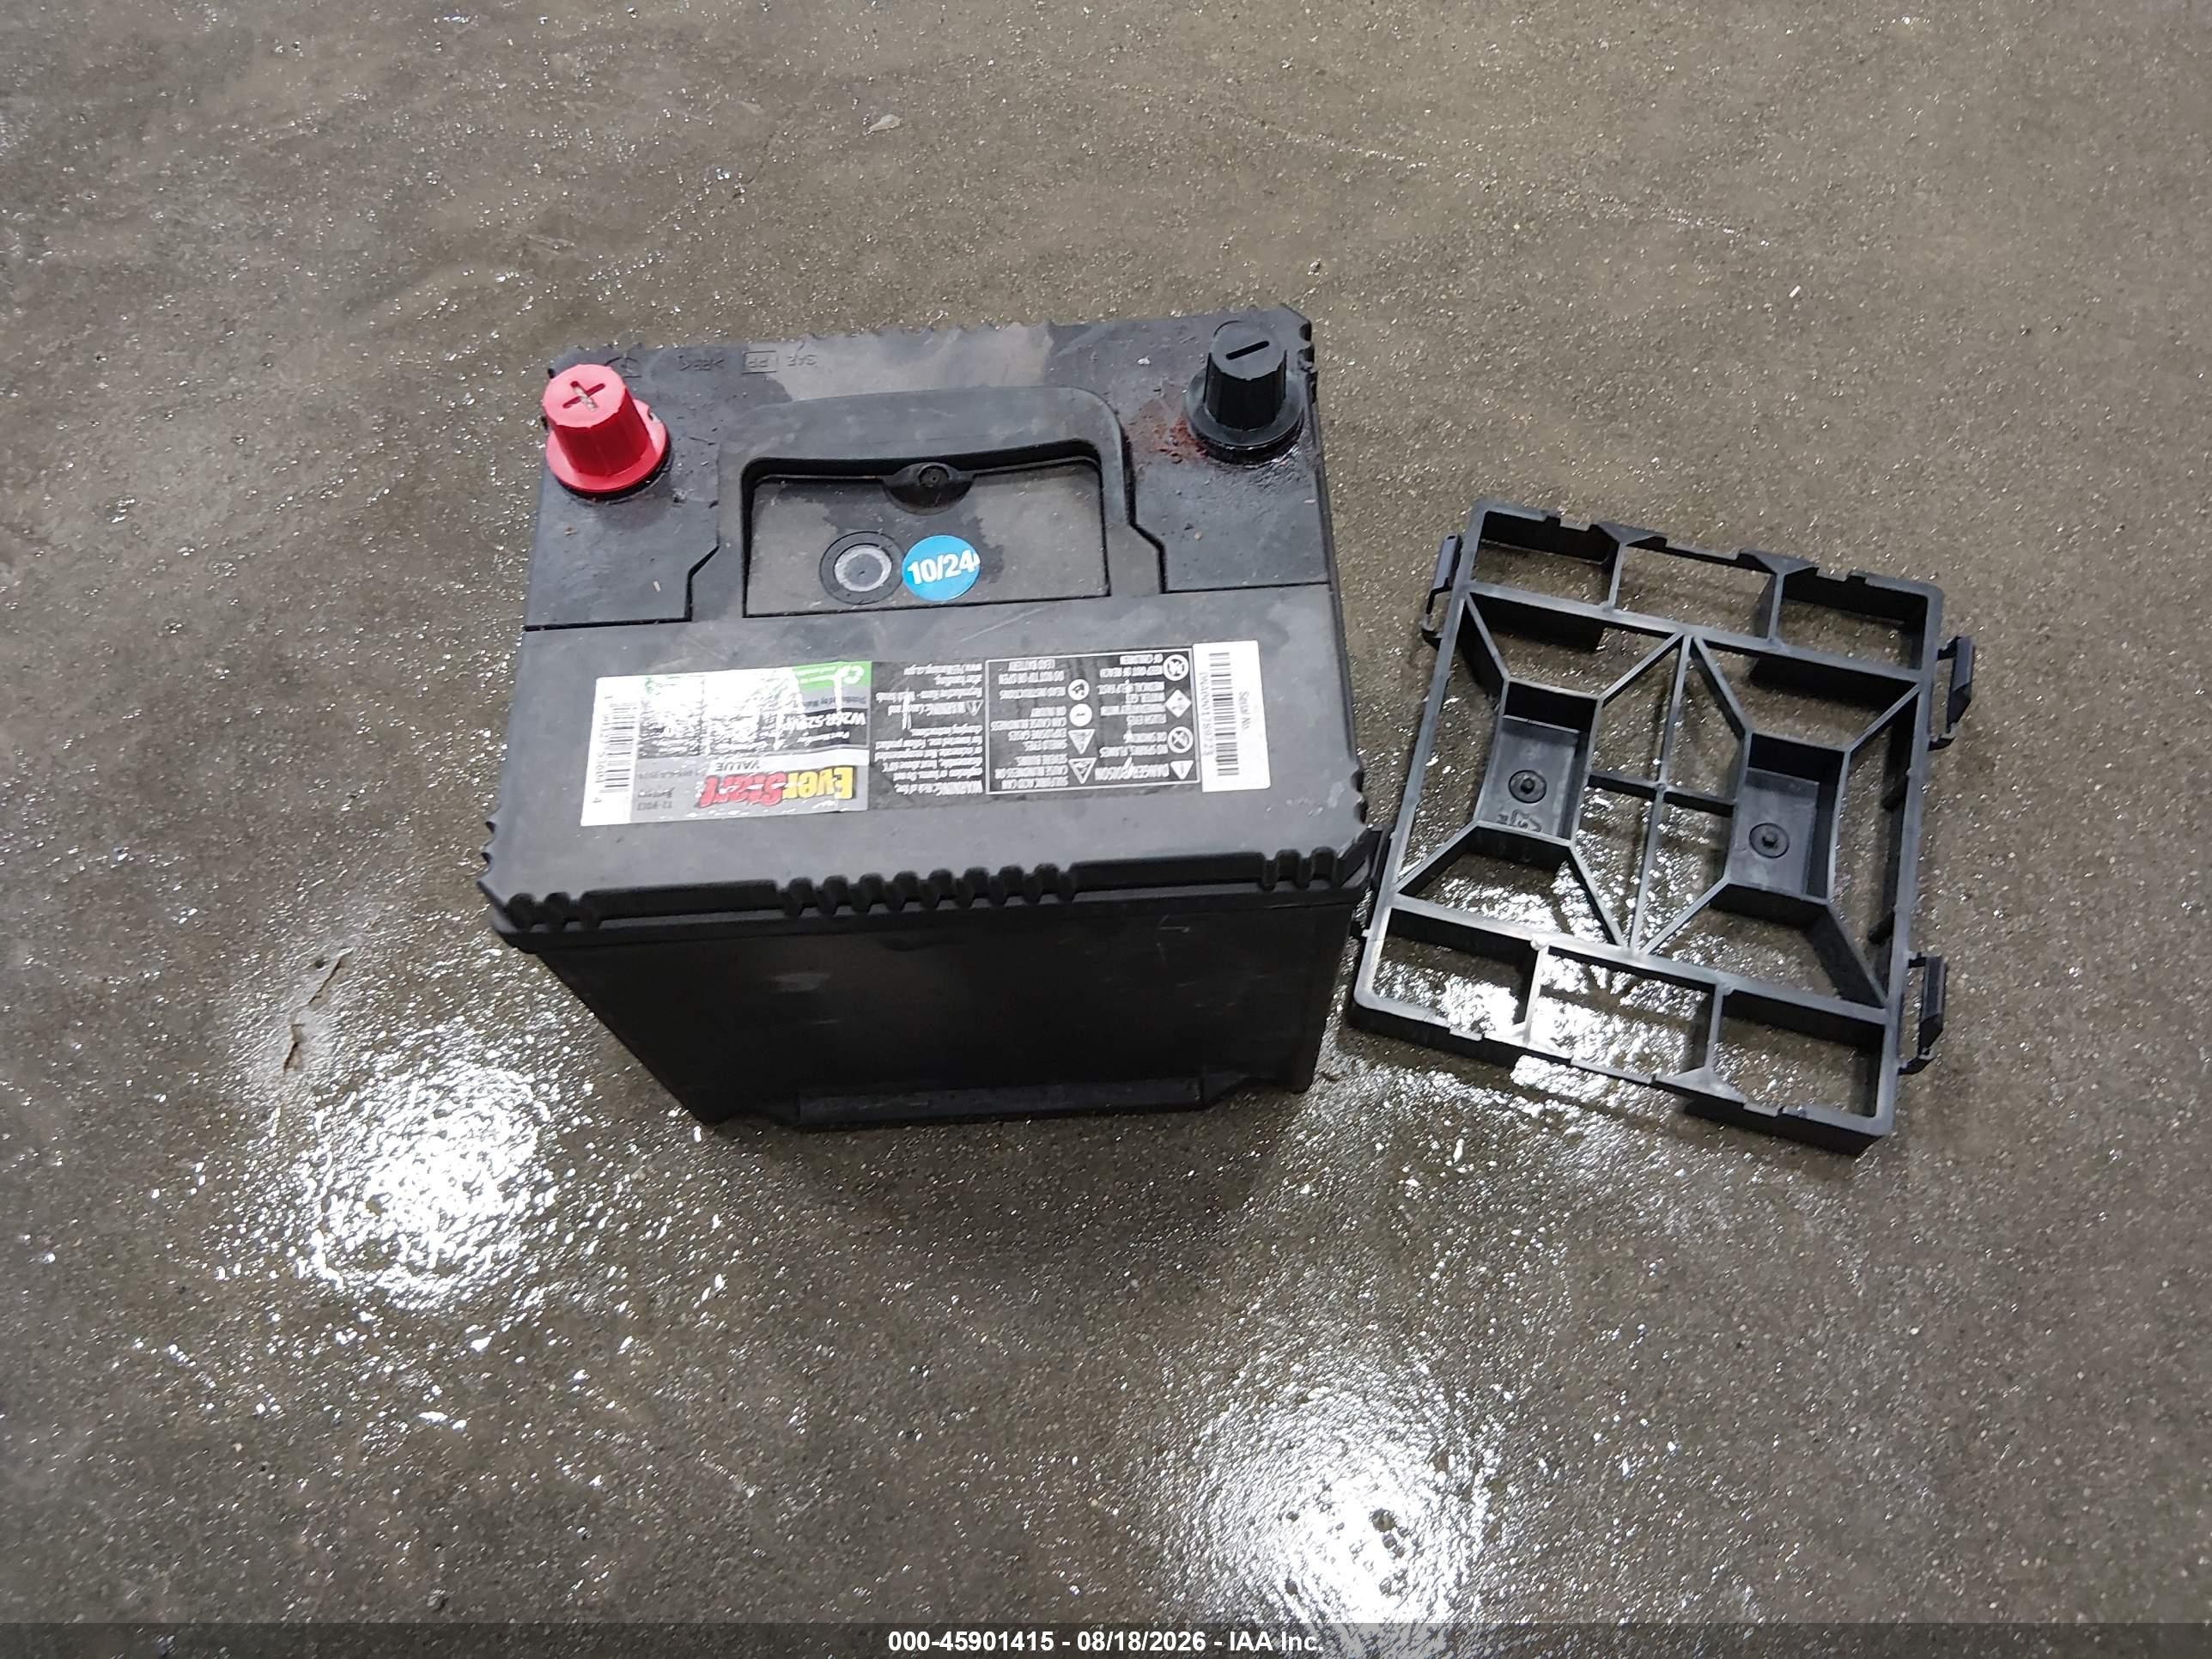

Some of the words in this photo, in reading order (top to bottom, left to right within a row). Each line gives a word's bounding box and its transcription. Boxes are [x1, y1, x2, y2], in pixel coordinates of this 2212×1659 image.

[908, 550, 976, 585] 10/24
[714, 759, 759, 770] VALUE
[694, 764, 855, 809] EverStart
